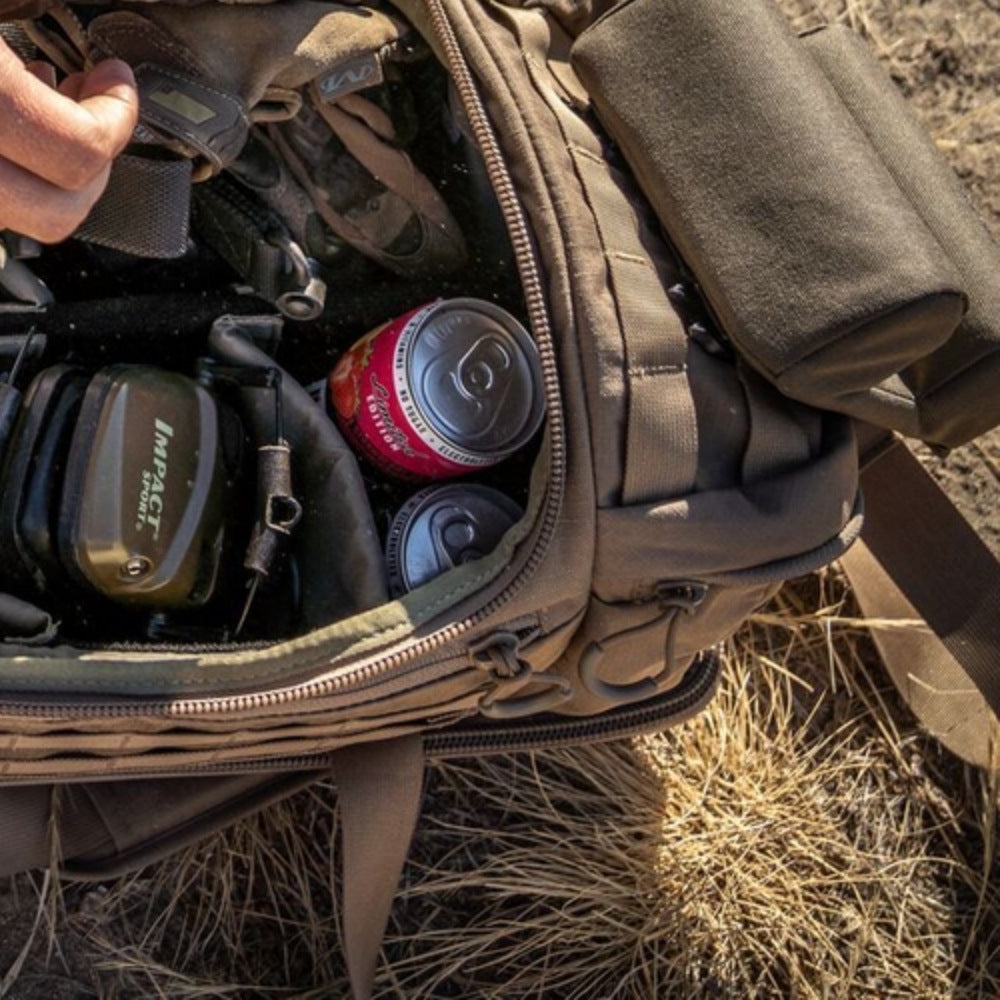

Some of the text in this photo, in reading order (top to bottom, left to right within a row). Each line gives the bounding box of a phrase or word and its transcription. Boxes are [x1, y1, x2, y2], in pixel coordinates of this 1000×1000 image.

[366, 394, 400, 452] EDITION
[137, 469, 152, 524] SPORT
[147, 417, 174, 533] IMPACT
